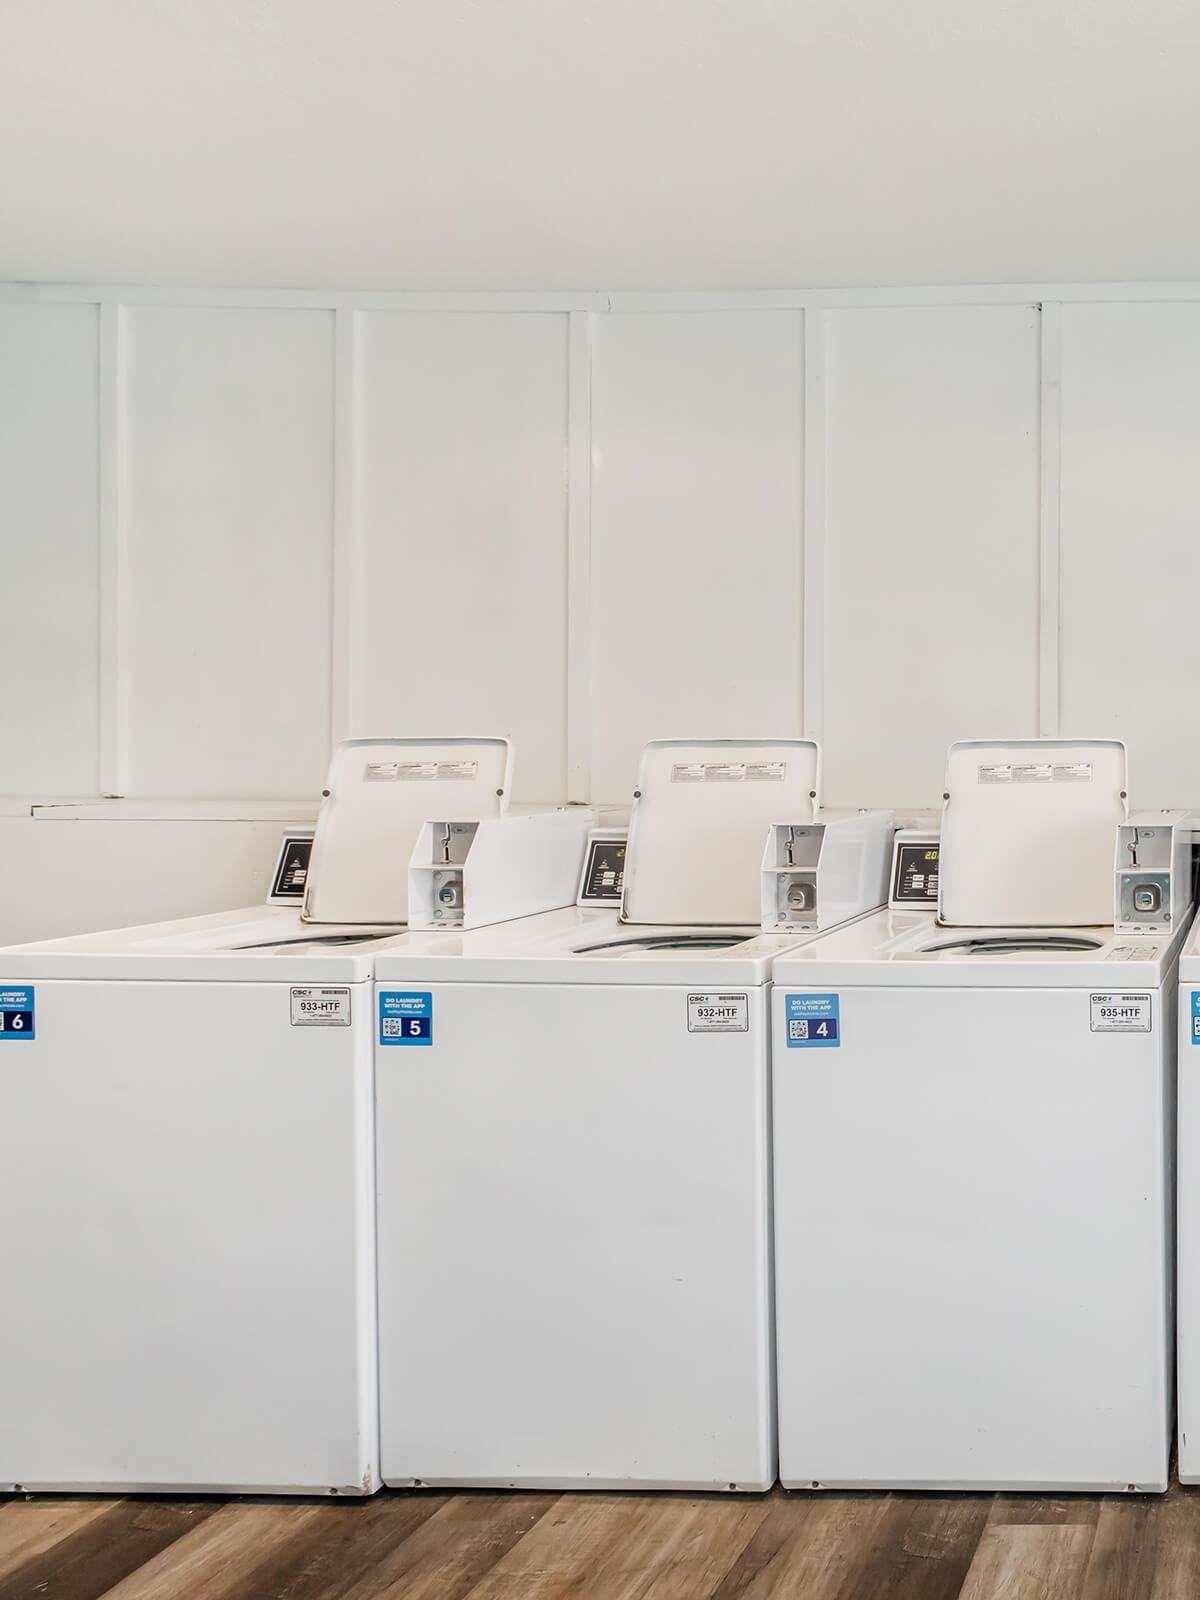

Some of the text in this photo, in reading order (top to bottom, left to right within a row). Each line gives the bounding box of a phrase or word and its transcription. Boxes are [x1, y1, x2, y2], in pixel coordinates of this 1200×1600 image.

[300, 1002, 340, 1010] 933-HTF
[697, 1008, 737, 1016] 932-HTF
[1100, 1008, 1141, 1016] 935-HTF
[12, 1014, 24, 1029] 6
[410, 1020, 421, 1036] 5
[816, 1021, 829, 1037] 4
